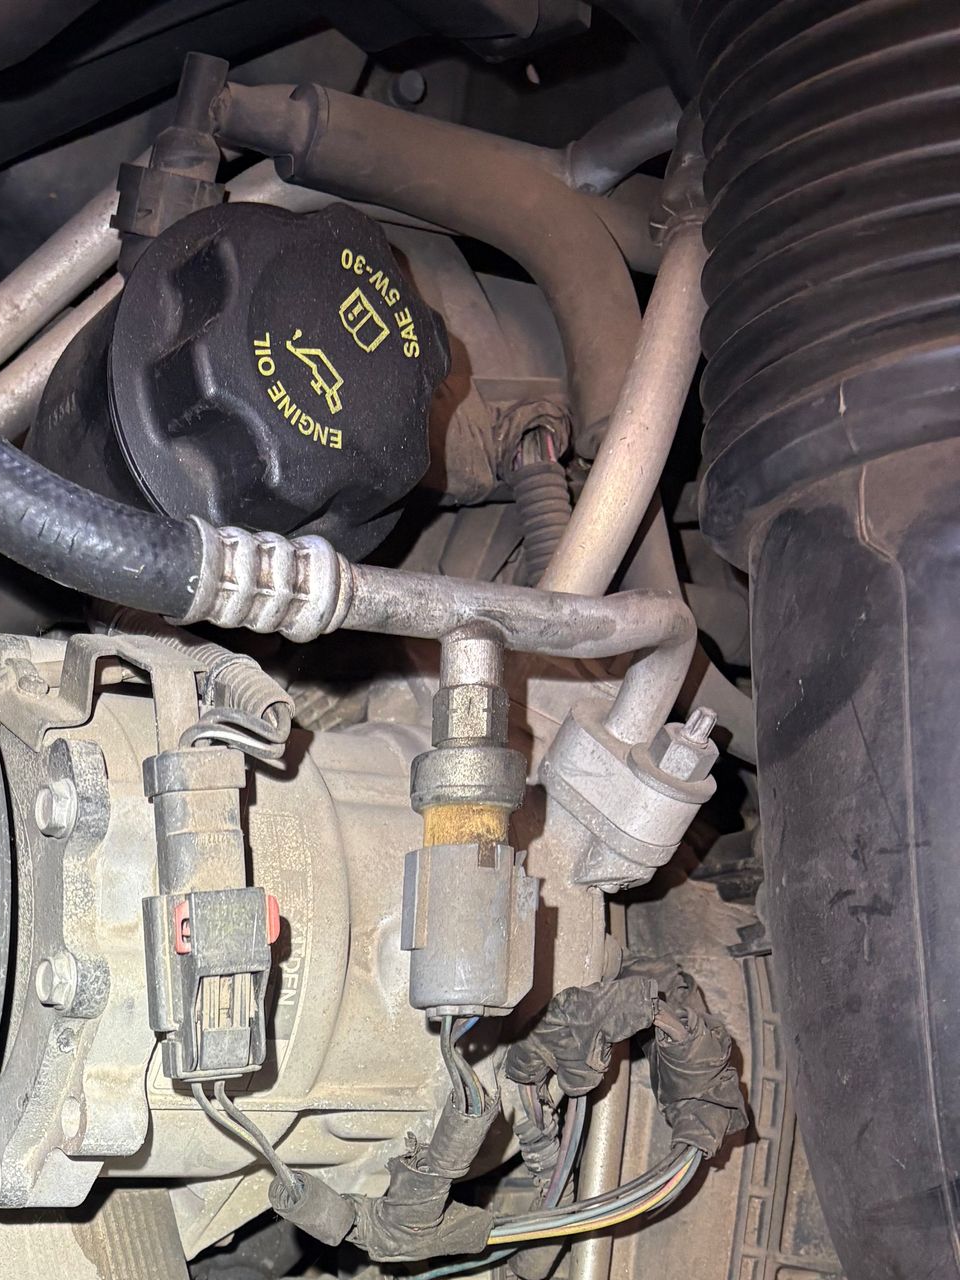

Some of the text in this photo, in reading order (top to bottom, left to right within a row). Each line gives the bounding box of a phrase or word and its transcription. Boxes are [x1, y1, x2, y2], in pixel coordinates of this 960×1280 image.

[340, 248, 420, 359] SAE 5W-30
[253, 332, 343, 450] ENGINE OIL
